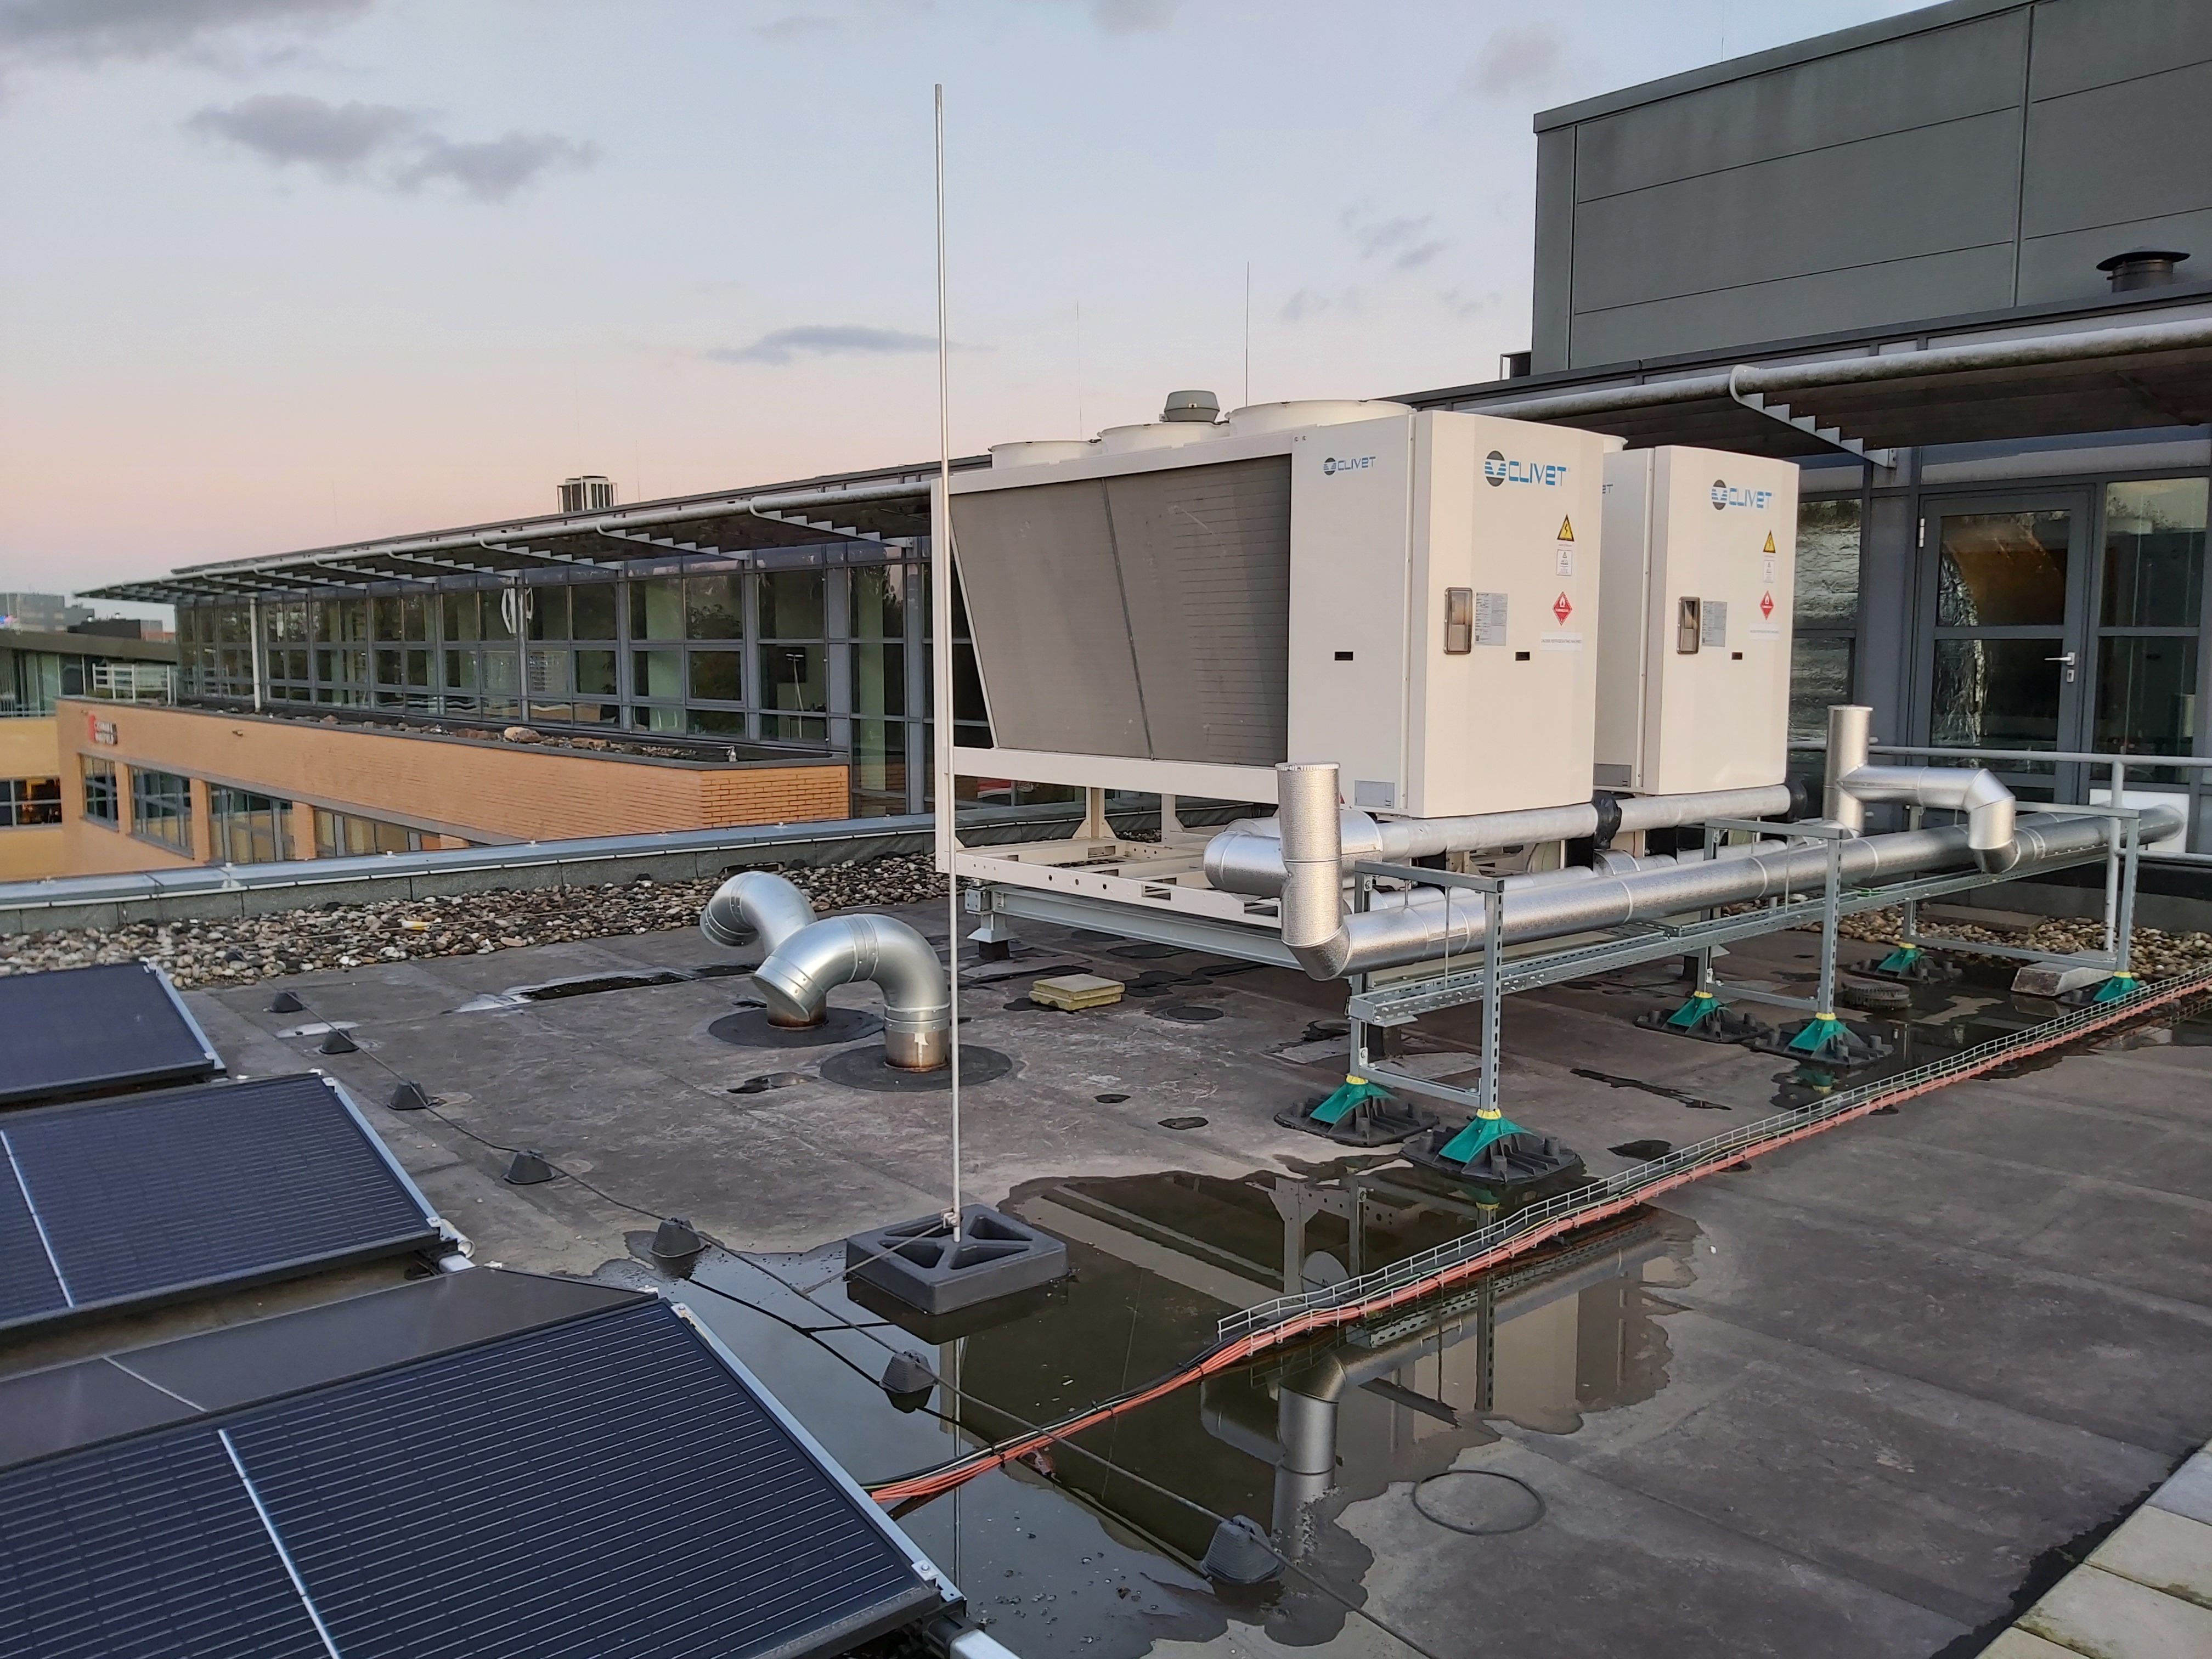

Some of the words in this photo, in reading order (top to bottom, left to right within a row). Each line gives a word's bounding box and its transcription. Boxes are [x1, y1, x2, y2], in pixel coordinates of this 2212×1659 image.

[1338, 456, 1376, 471] CLIVET
[1508, 460, 1567, 487] CLIVET
[1729, 487, 1773, 510] CLIVET
